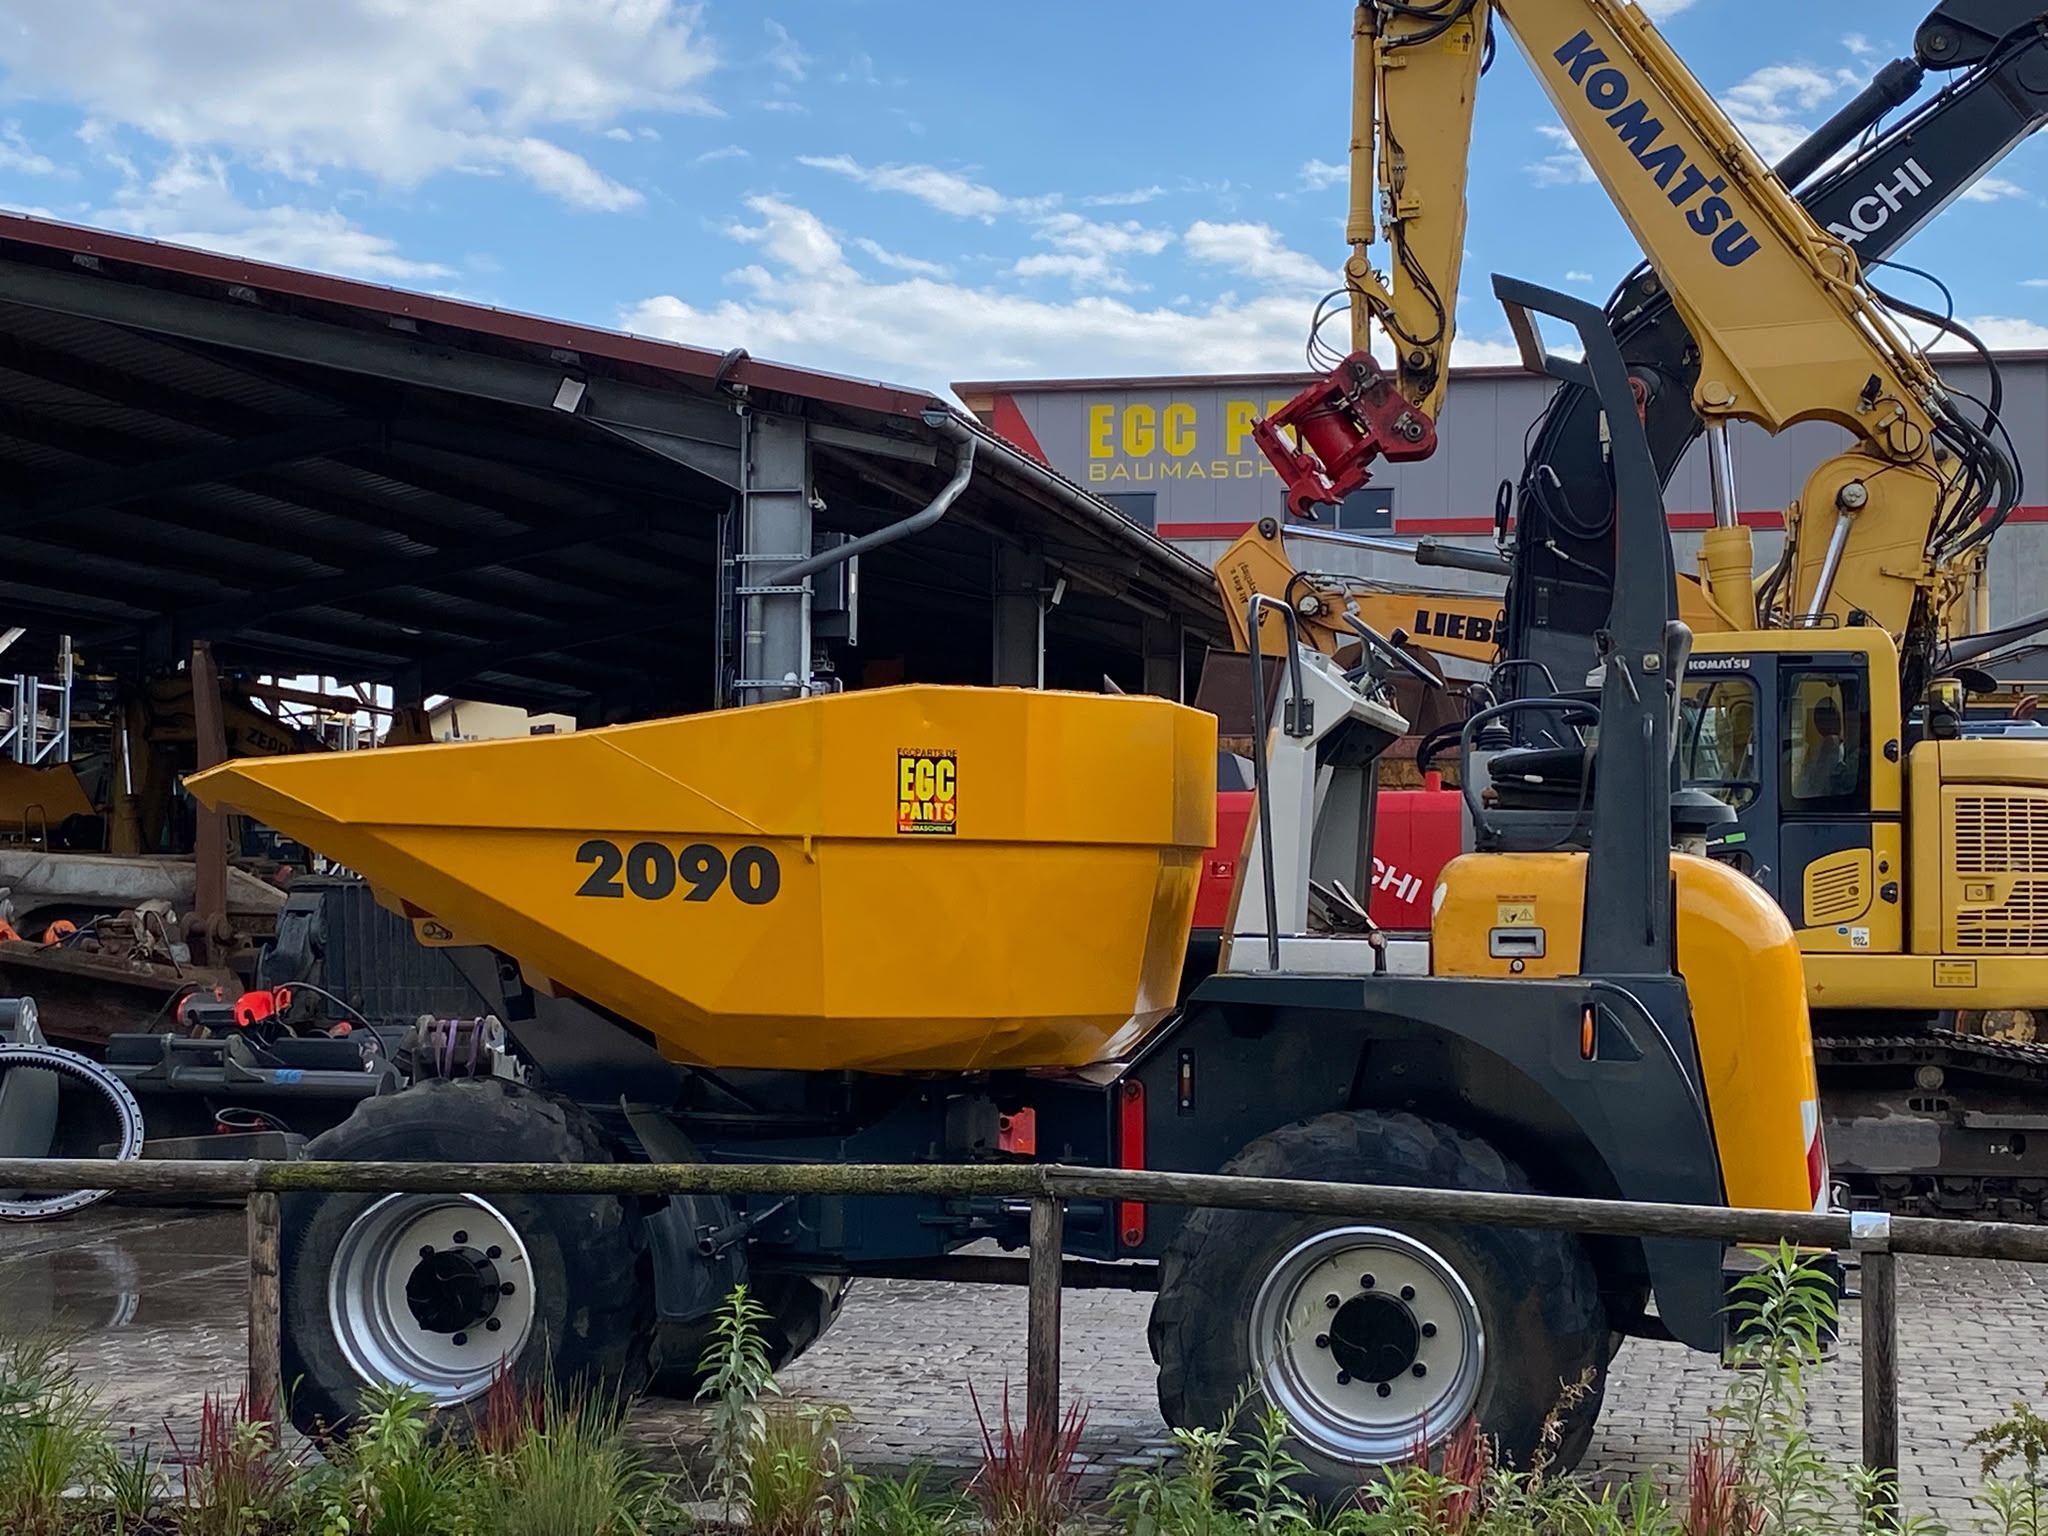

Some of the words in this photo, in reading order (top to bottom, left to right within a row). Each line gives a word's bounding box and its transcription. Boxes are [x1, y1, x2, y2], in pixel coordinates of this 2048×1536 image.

[1553, 29, 1762, 267] KOMATSU
[1089, 403, 1197, 458] EGC
[1688, 656, 1751, 670] KOMATSU
[900, 758, 955, 802] EGC
[900, 802, 955, 821] PARTS
[574, 839, 781, 905] 2090
